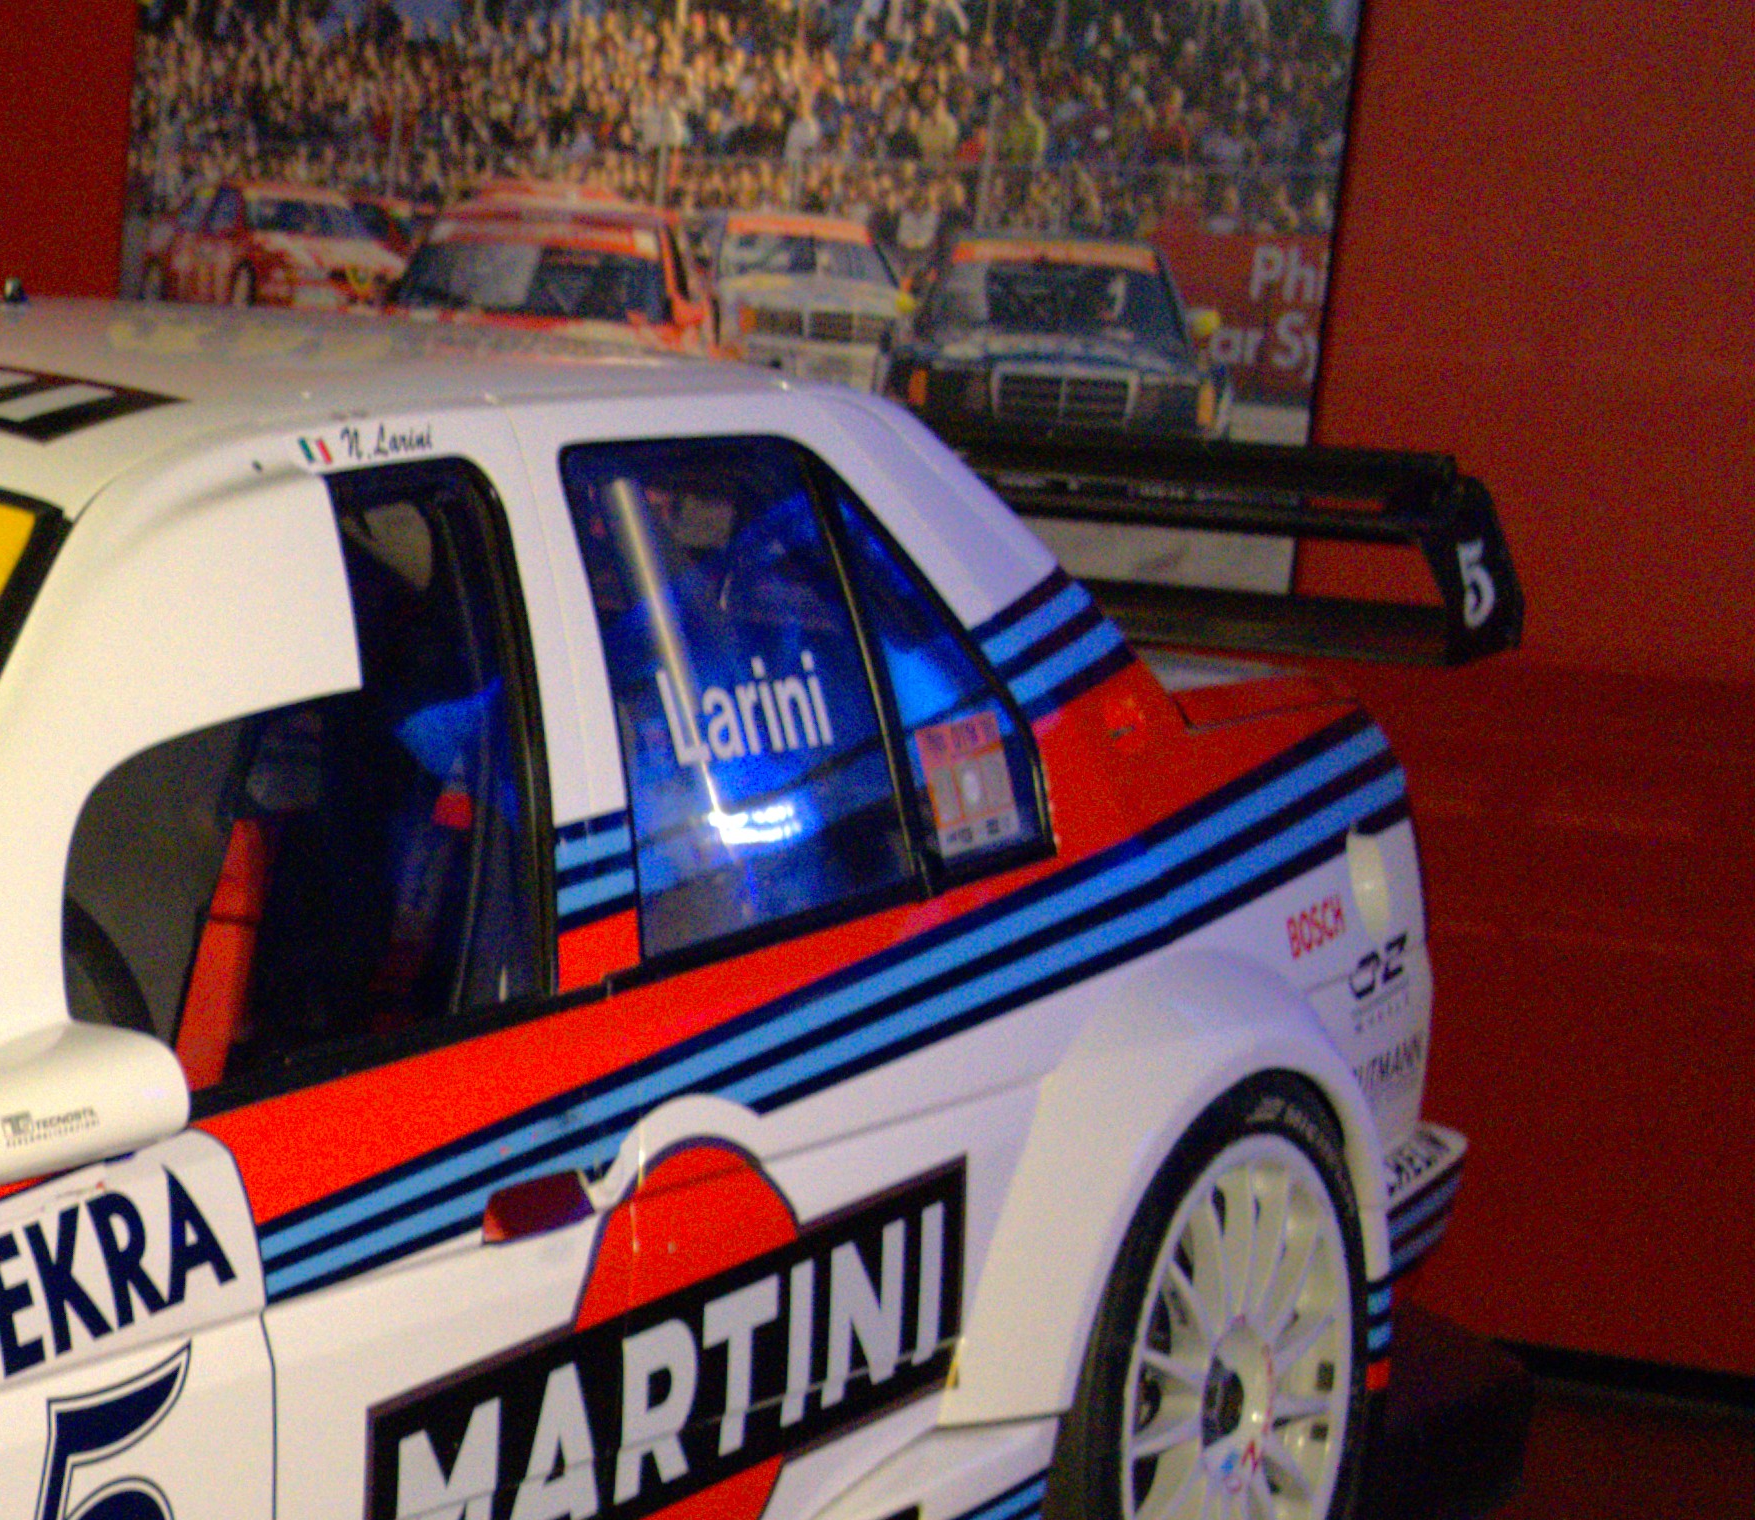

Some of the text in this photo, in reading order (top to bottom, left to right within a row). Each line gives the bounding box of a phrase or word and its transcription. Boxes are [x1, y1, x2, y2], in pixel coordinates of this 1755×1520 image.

[1457, 537, 1495, 630] 5
[655, 649, 833, 767] Larini
[1286, 893, 1346, 961] BOSCH
